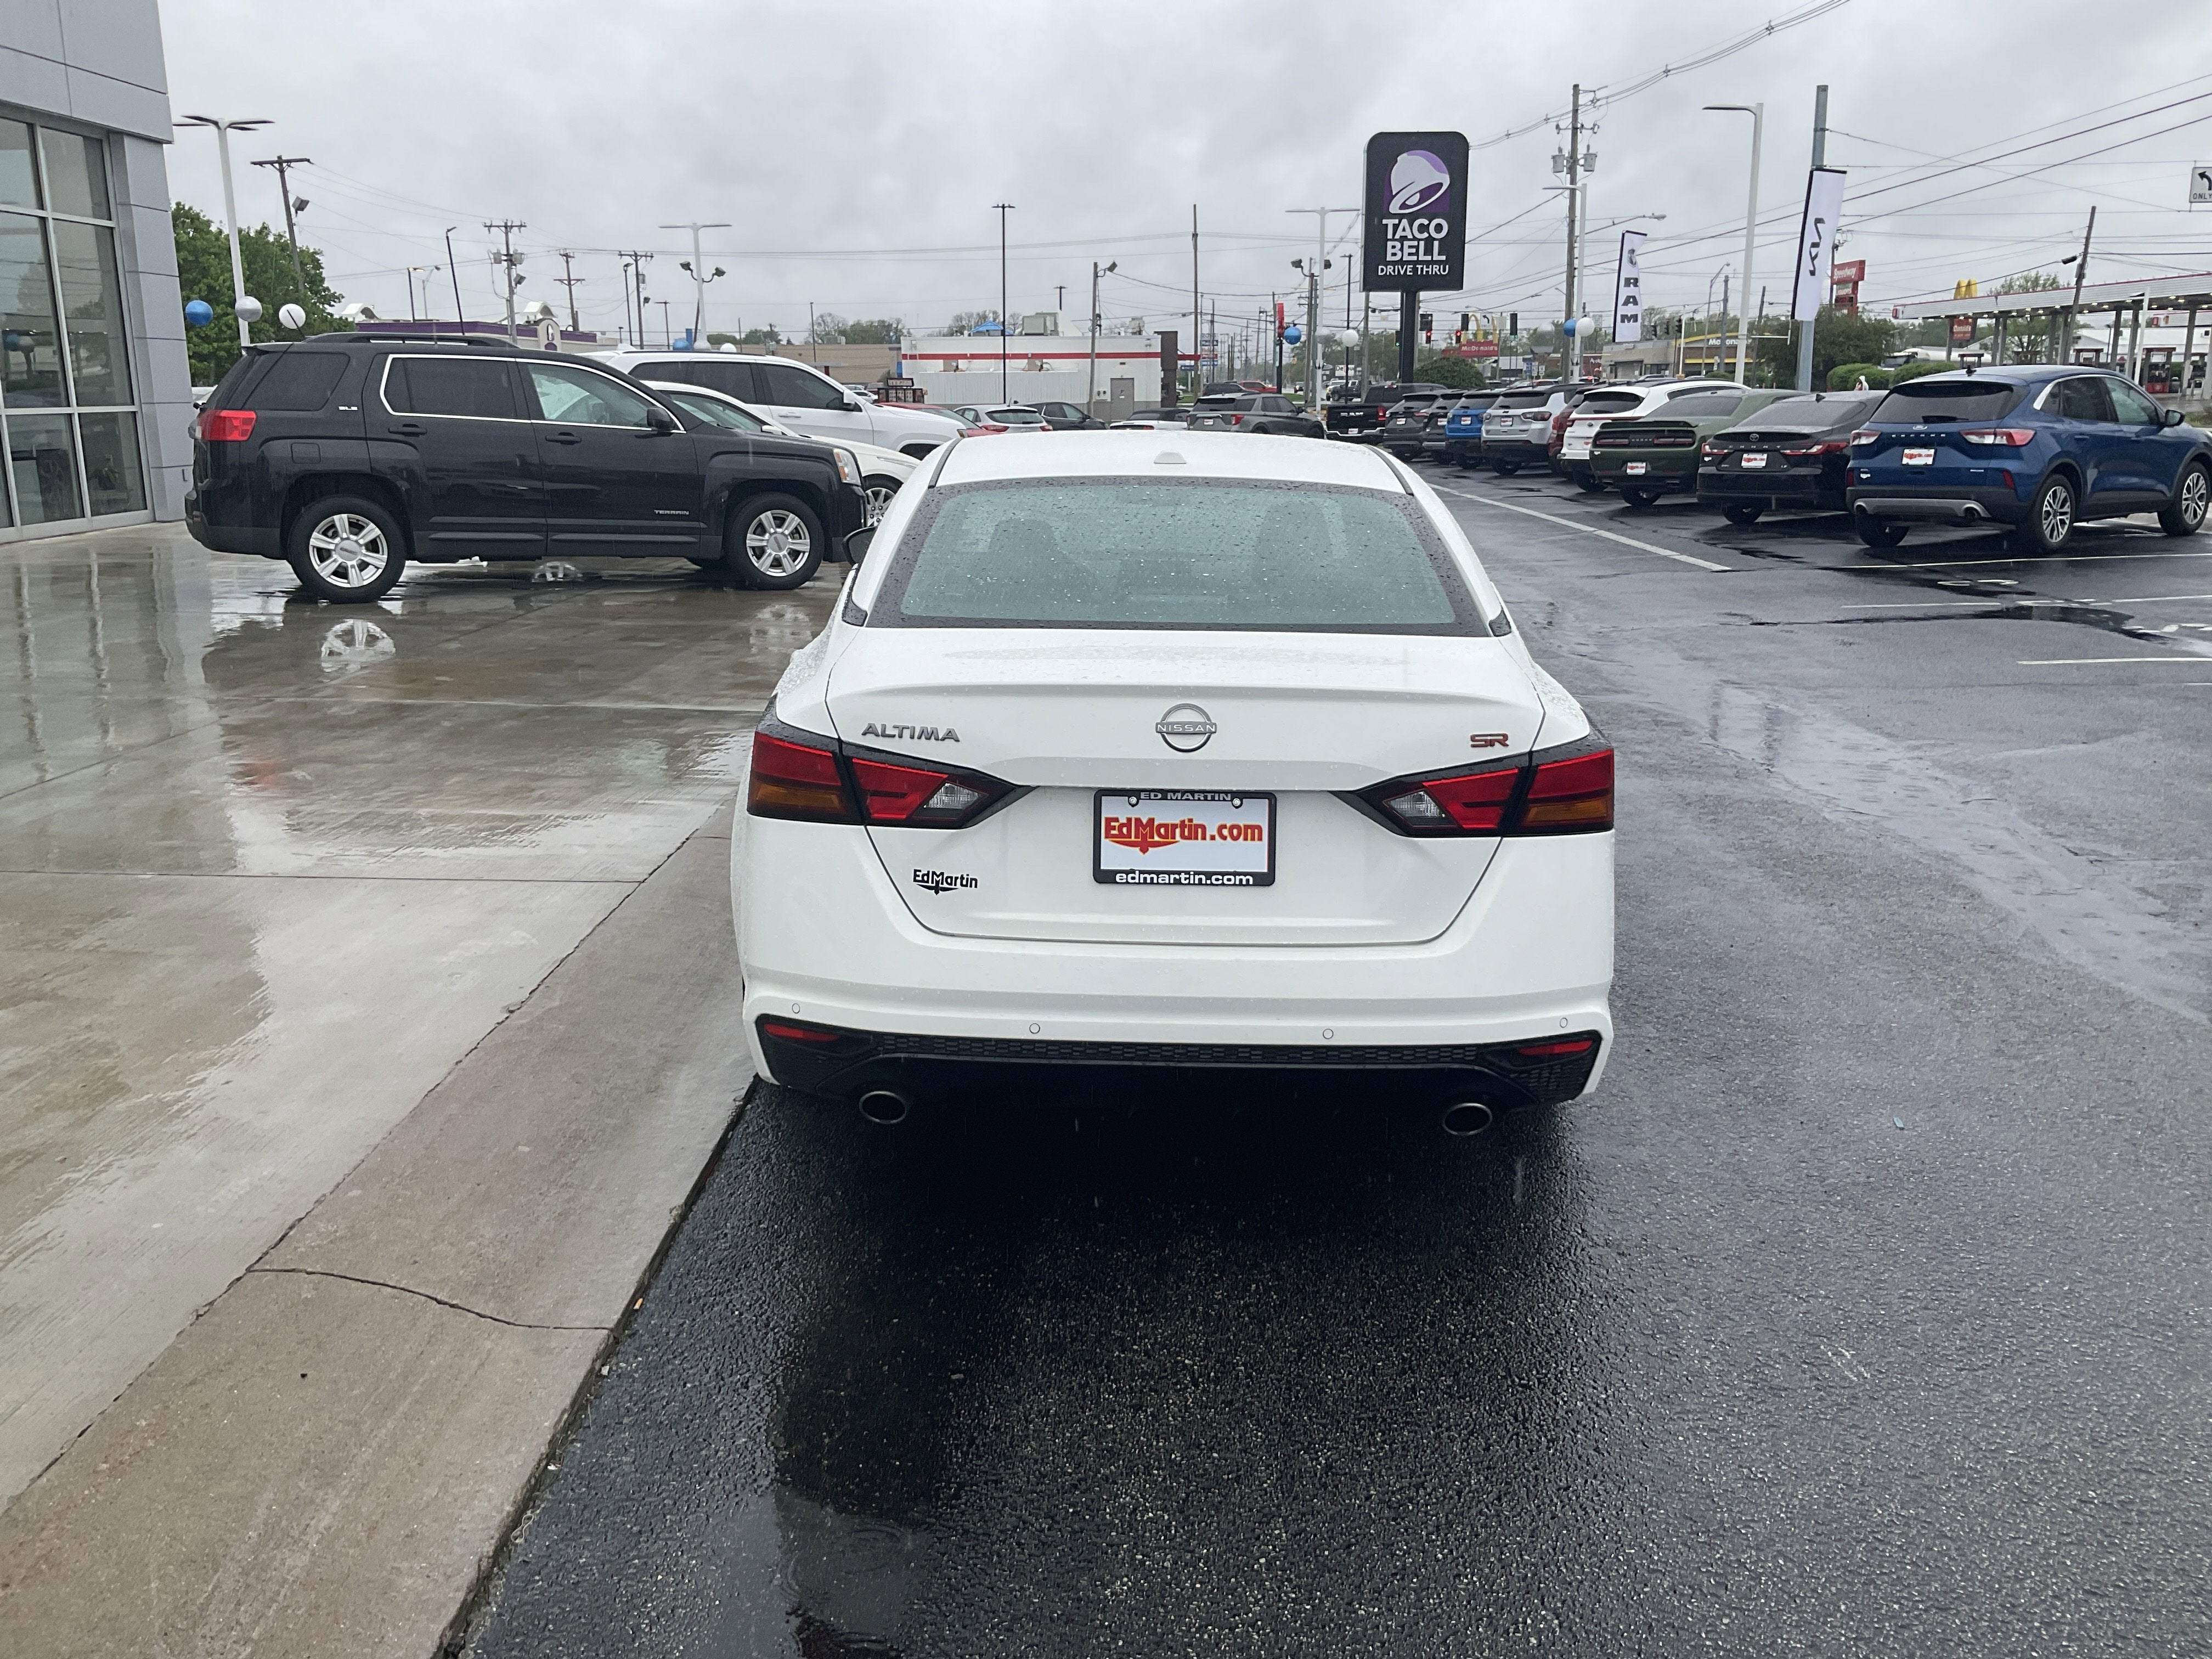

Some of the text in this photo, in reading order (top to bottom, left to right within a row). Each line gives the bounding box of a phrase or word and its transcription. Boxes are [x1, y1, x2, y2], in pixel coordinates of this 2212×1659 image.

[1382, 218, 1448, 239] TACO
[1386, 240, 1446, 261] BELL
[1378, 264, 1449, 275] DRIVE THRU
[1620, 277, 1639, 323] RAM
[861, 723, 960, 742] ALTIMA
[1471, 733, 1509, 747] SR
[1167, 792, 1231, 800] MARTIN
[1104, 816, 1263, 855] EdMartin.com
[913, 869, 978, 895] EdMartin
[1115, 871, 1253, 885] edmartin.com
